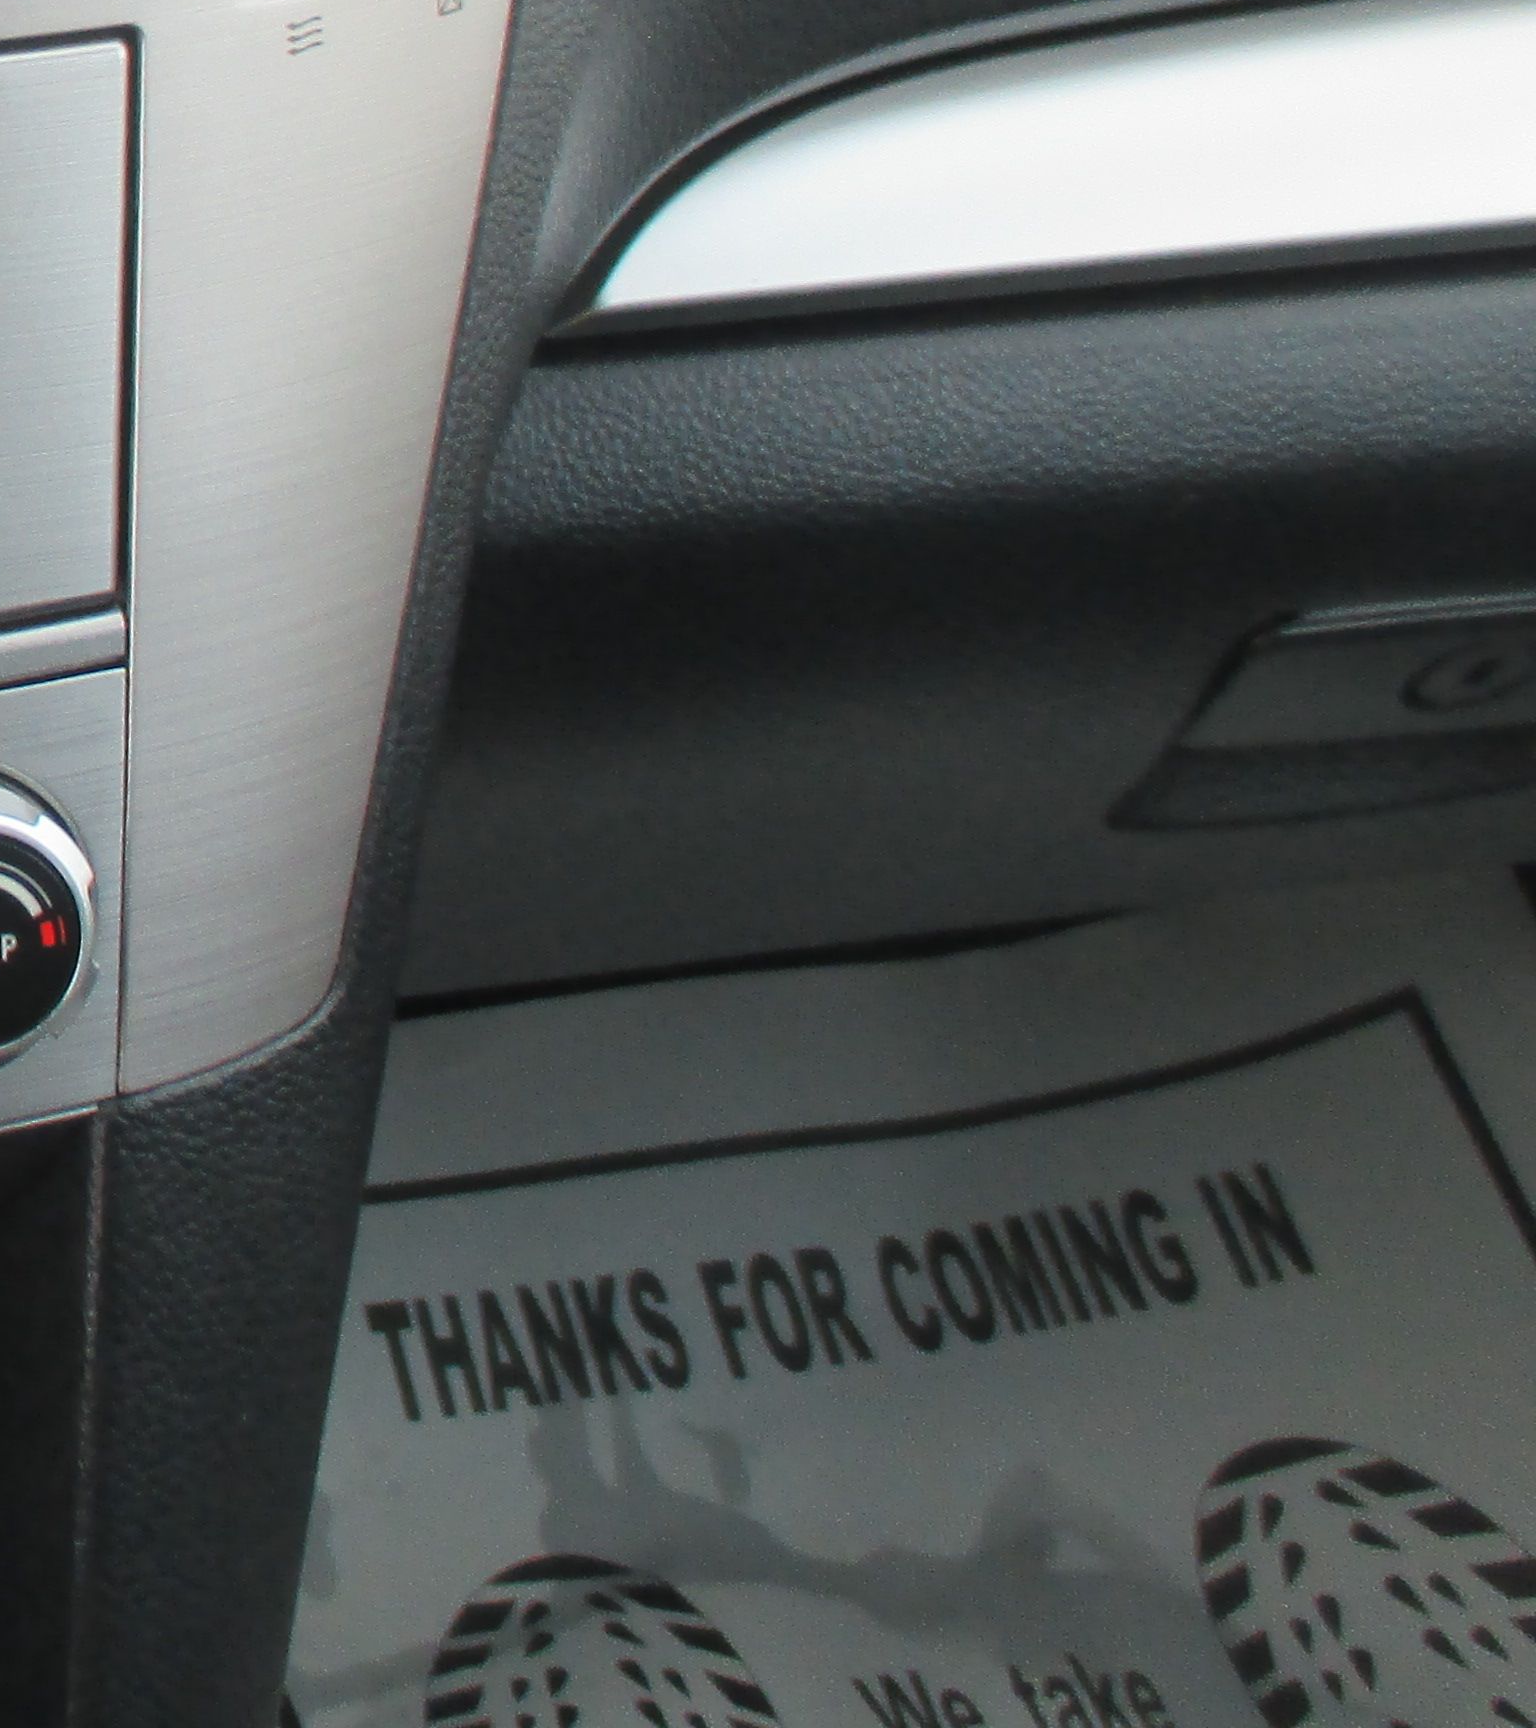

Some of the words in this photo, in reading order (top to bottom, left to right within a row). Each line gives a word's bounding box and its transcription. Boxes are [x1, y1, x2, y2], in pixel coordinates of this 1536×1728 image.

[364, 1267, 693, 1421] THANKS
[696, 1254, 875, 1380] FOR
[879, 1189, 1199, 1354] COMING
[1196, 1162, 1318, 1290] IN
